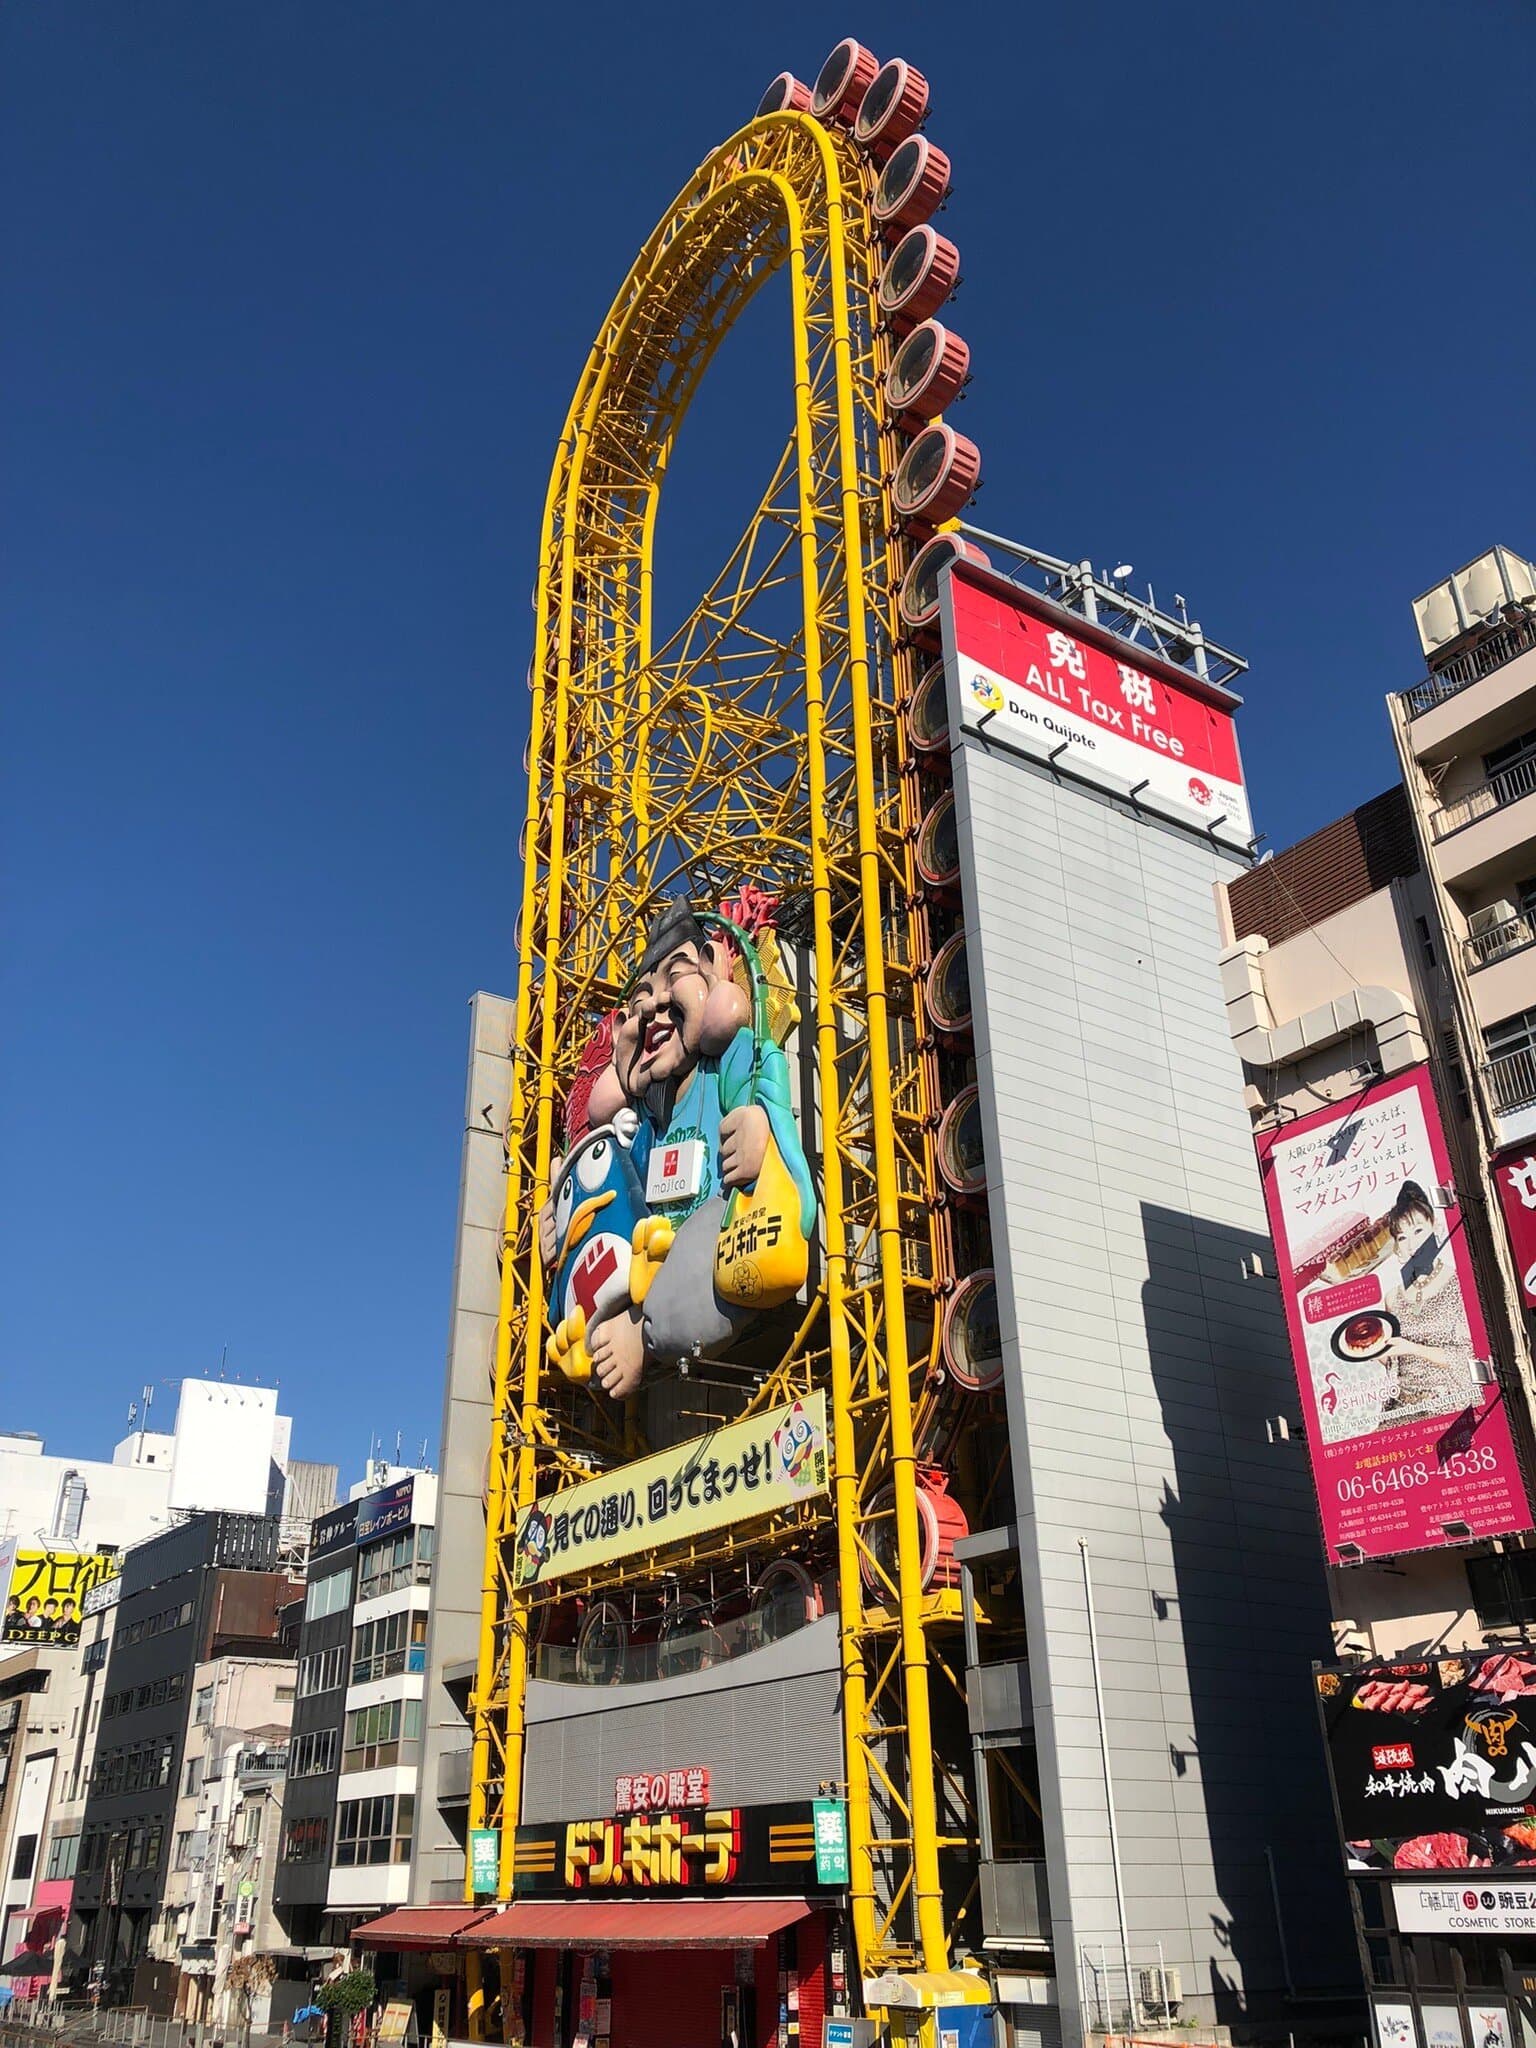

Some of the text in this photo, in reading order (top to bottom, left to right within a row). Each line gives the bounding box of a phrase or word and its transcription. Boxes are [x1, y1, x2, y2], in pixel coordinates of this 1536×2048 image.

[1009, 700, 1097, 750] Don Quijote
[1026, 663, 1184, 758] ALL Tax Free
[1290, 1123, 1408, 1179] マダムシンコ
[1295, 1161, 1417, 1214] マダムブリュレ
[1342, 1384, 1400, 1411] SHINCO
[1337, 1446, 1497, 1502] 06-6468-4538
[8, 1629, 60, 1641] DEEP
[615, 1768, 710, 1813] 驚安の殿堂
[1364, 1770, 1435, 1798] 和牛焼肉
[1485, 1806, 1525, 1815] NIKUHACHI
[816, 1811, 843, 1845] 薬
[474, 1837, 495, 1863] 薬
[1448, 1917, 1536, 1928] COSMETIC STORE
